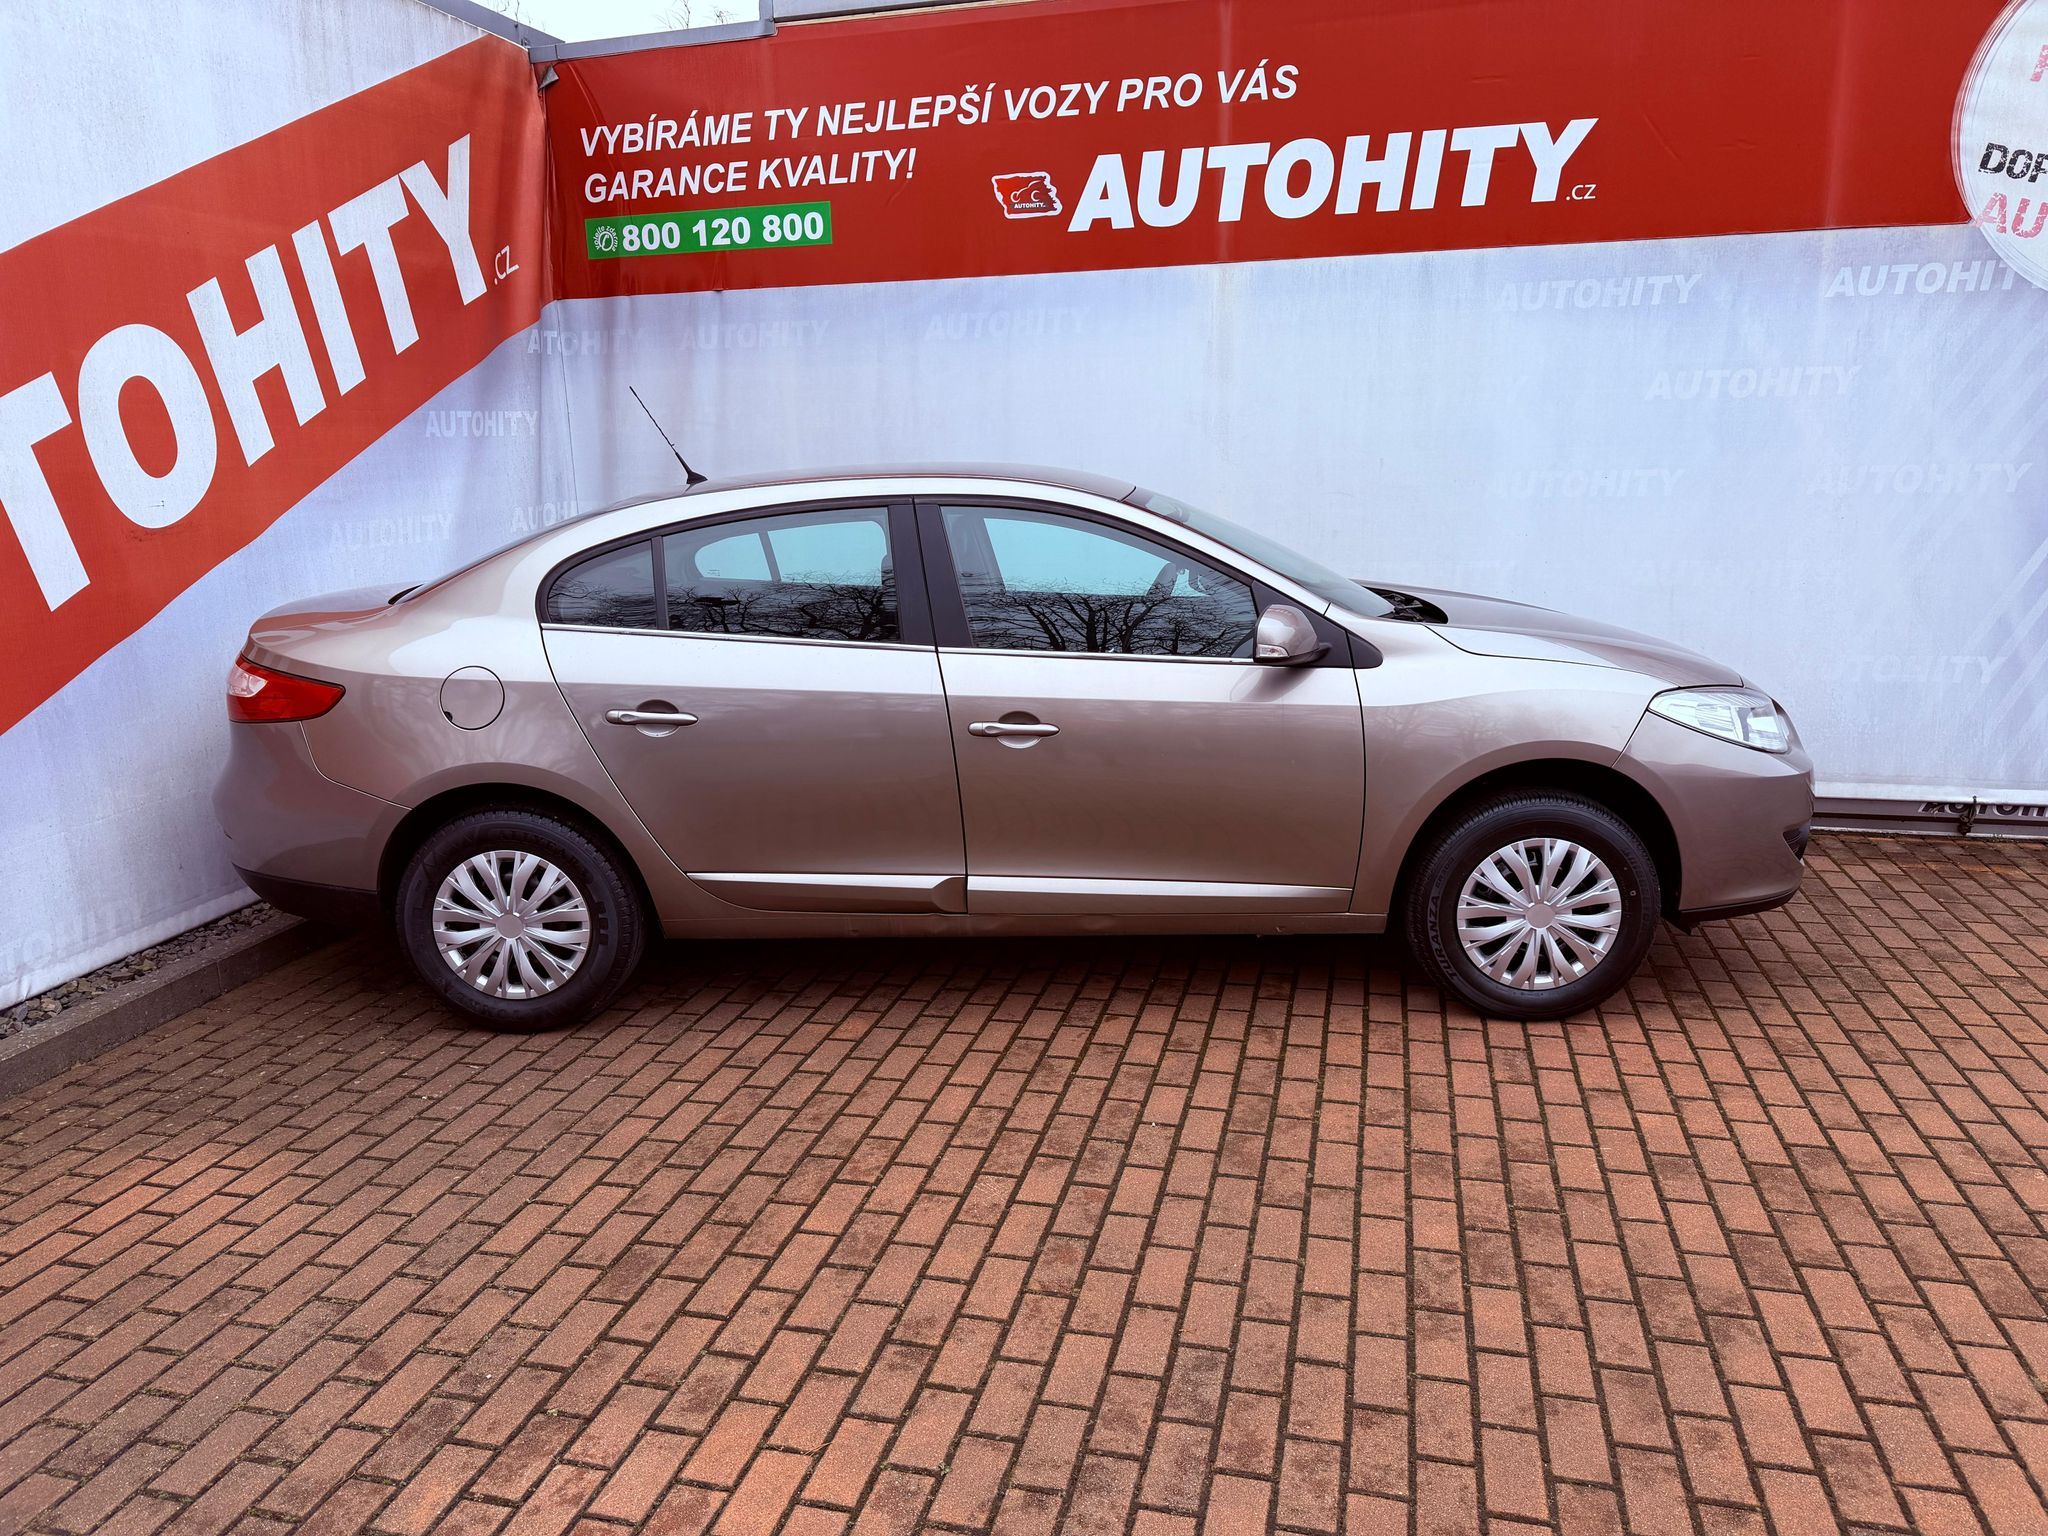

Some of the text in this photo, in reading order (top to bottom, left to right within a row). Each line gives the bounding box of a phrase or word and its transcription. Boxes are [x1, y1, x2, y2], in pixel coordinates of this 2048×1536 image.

[580, 58, 1299, 157] VYBÍRÁME TY NEJLEPŠÍ VOZY PRO VÁS
[584, 147, 917, 203] GARANCE KVALITY!
[622, 211, 824, 252] 800 120 800
[1496, 274, 1702, 312] AUTOHITY
[1824, 260, 2047, 298] AUTOHIT
[426, 410, 538, 438] AUTOHITY
